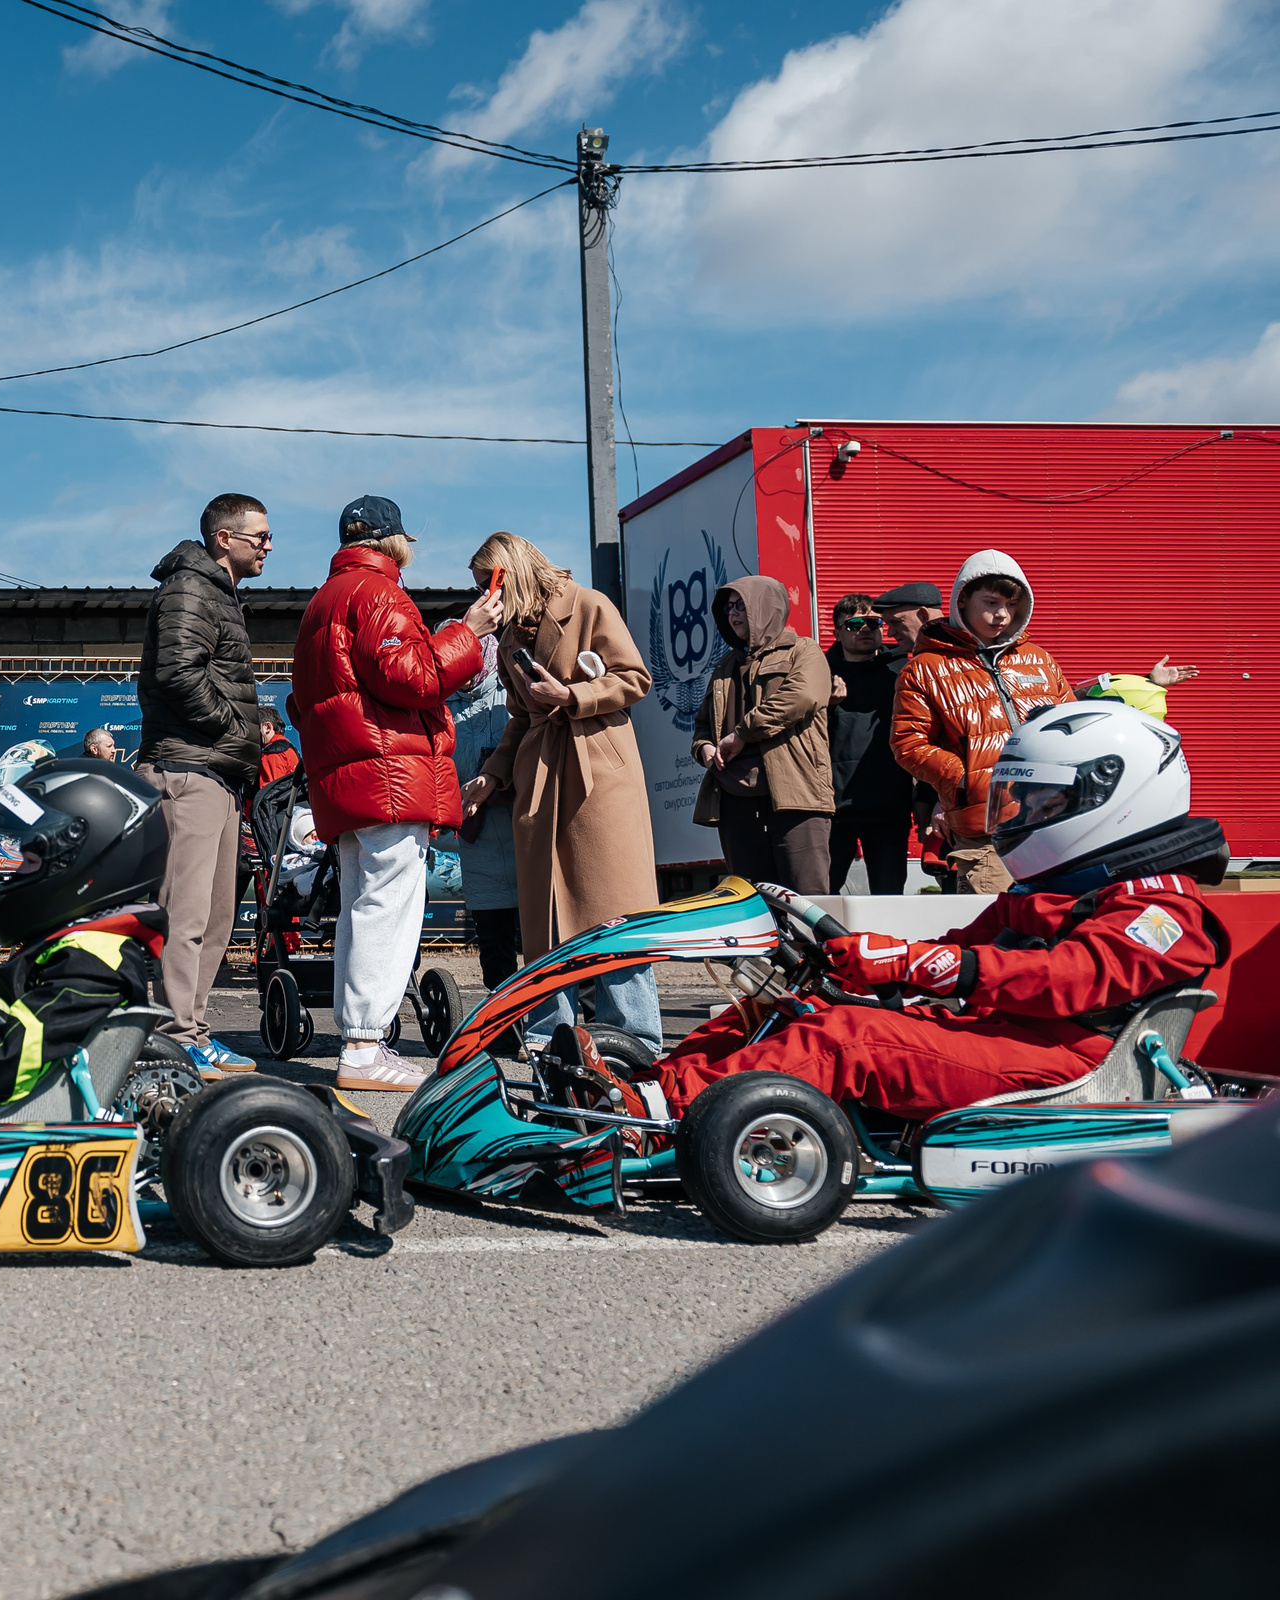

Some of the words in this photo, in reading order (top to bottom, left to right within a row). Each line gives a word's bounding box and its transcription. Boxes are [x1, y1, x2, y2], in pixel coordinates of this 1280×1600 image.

[675, 754, 696, 771] федер
[999, 767, 1035, 778] RACING
[873, 956, 899, 966] FIRST
[927, 951, 956, 977] OMP
[971, 1160, 1057, 1176] FORM
